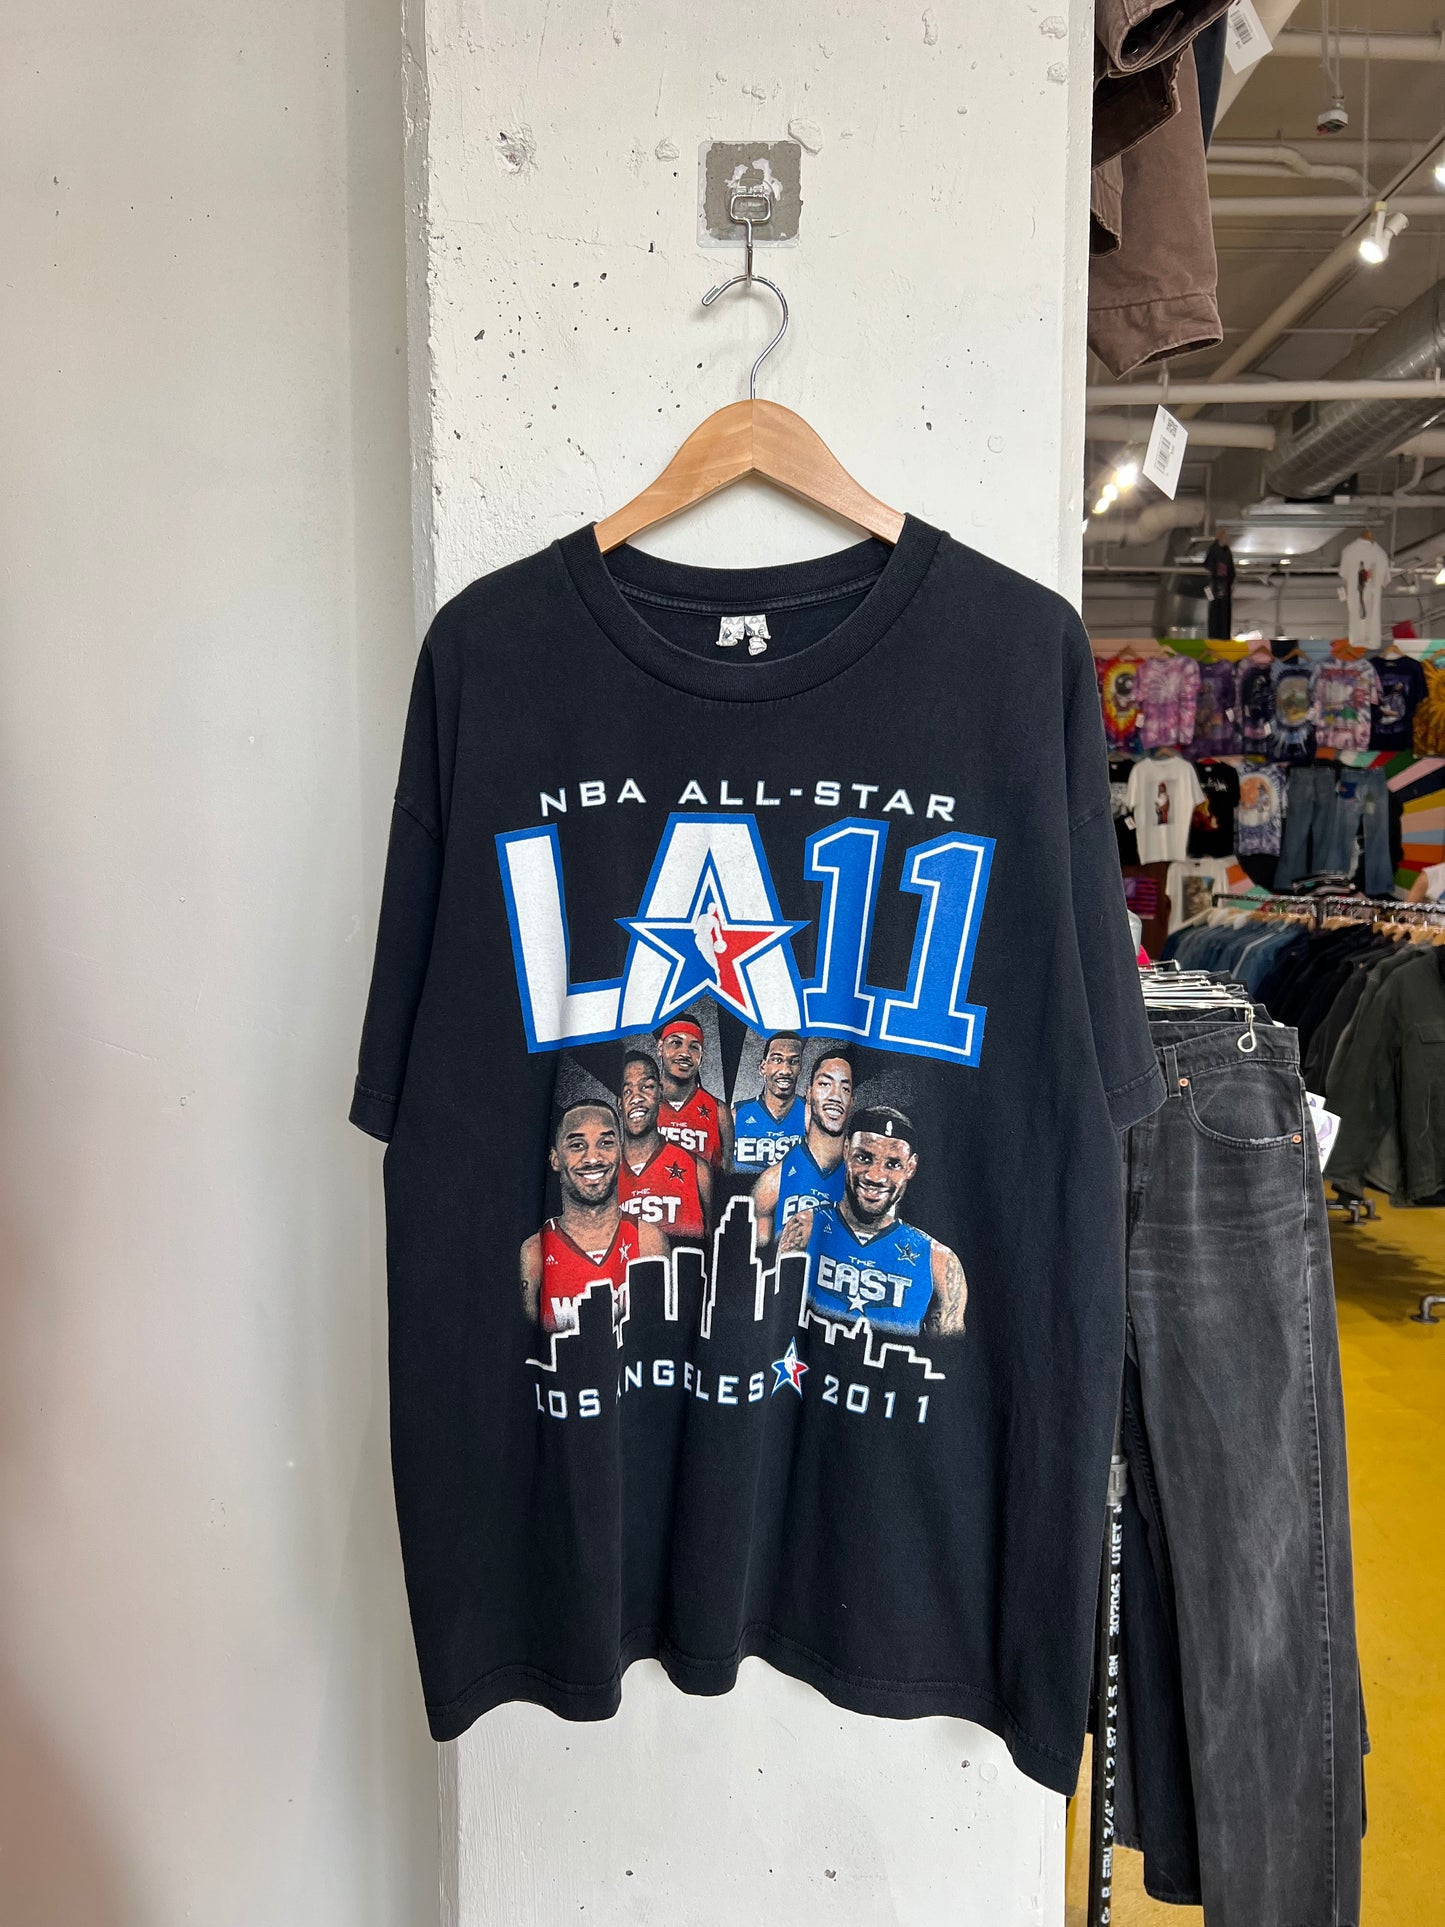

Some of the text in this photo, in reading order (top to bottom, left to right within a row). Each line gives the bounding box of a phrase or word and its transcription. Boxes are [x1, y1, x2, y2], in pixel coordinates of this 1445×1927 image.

[539, 778, 957, 822] NBA ALL-STAR
[631, 1188, 651, 1197] THE
[817, 1254, 913, 1308] EAST
[848, 1255, 877, 1268] THE
[535, 1359, 766, 1419] LOS NGELES
[822, 1373, 930, 1424] 2011
